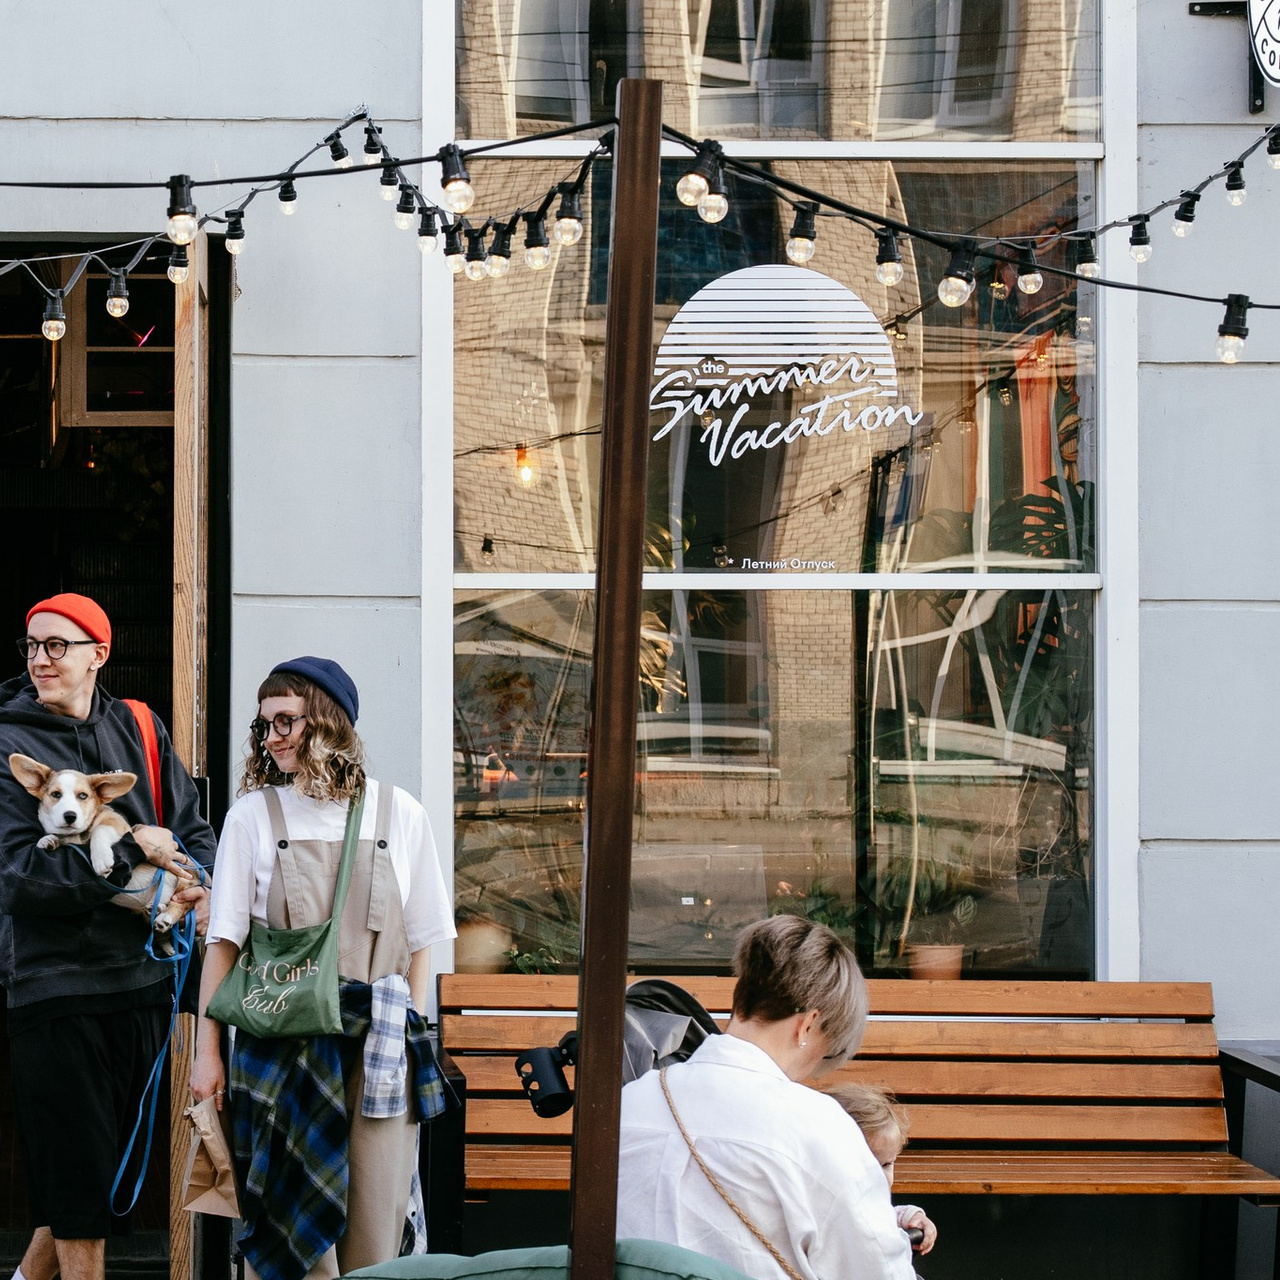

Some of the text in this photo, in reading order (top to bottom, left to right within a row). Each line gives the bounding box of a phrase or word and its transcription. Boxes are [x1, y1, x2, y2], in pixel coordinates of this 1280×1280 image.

[702, 361, 725, 374] the
[649, 355, 871, 442] Summer
[700, 385, 924, 467] Vacation
[741, 557, 836, 571] Летний Отпуск
